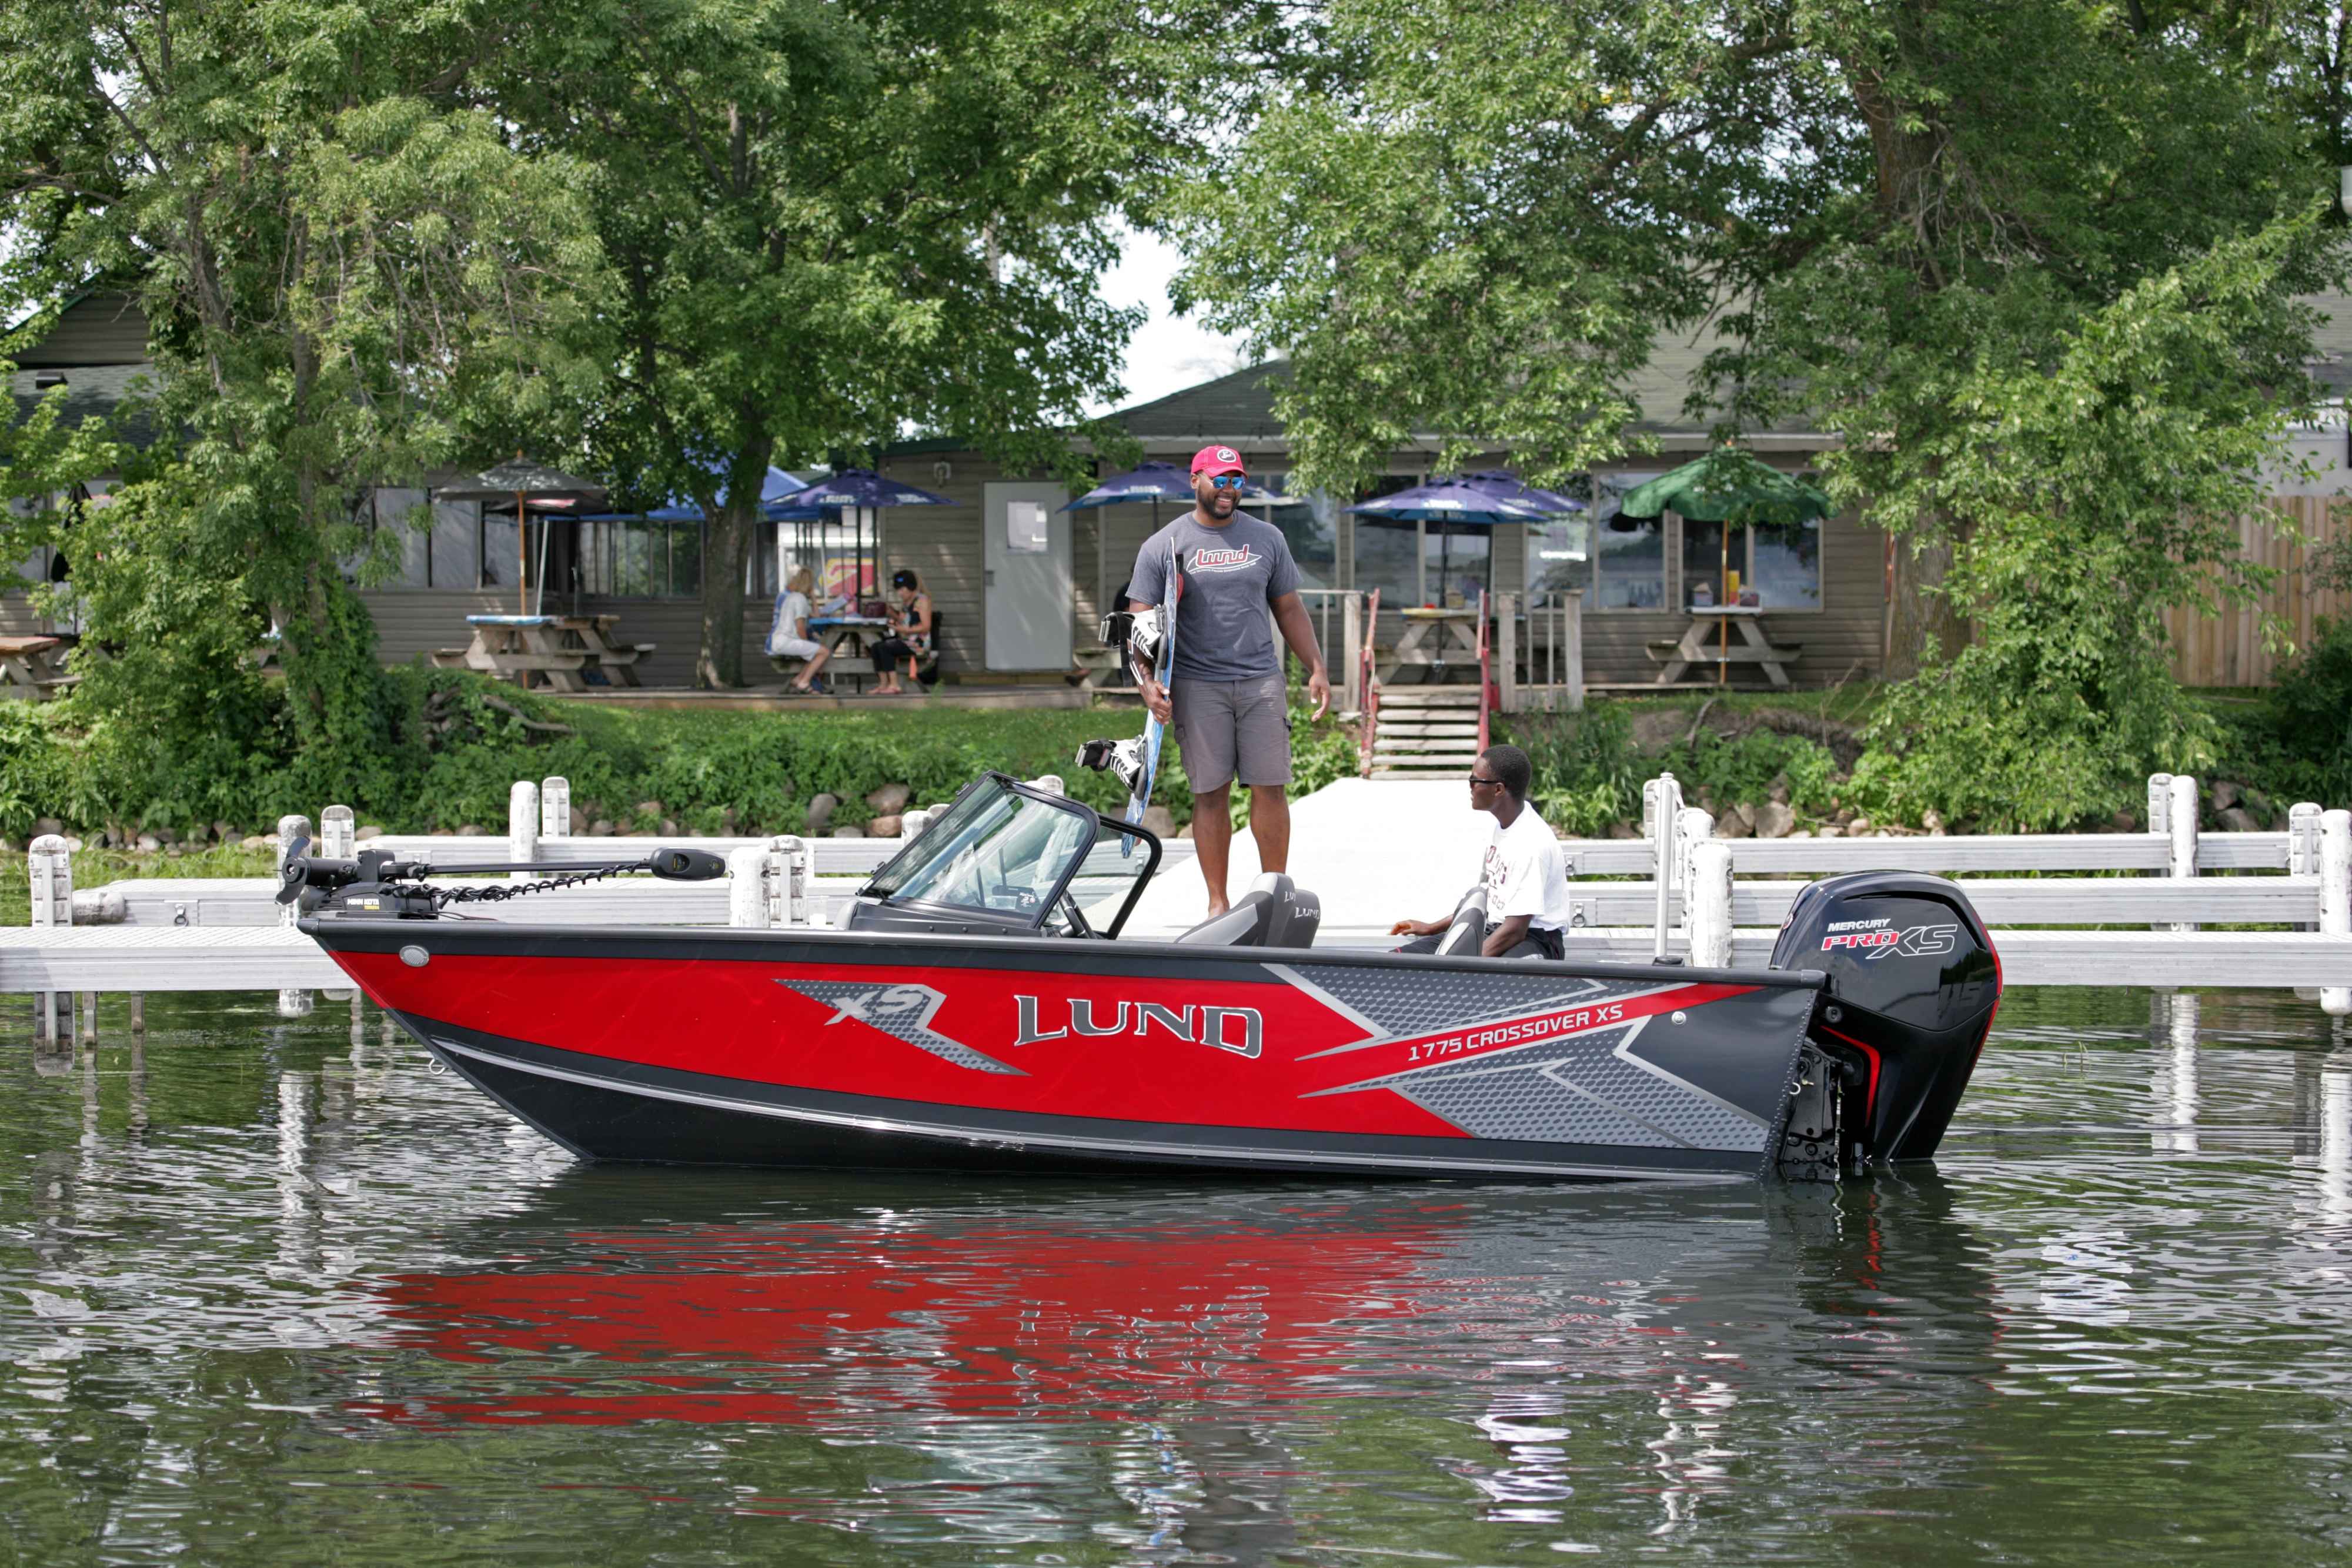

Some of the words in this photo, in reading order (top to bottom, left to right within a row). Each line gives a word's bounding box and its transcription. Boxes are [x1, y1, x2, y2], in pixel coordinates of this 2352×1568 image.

[1295, 907, 1320, 920] LUND
[1828, 918, 1890, 932] MERCURY
[1821, 931, 1900, 951] PRO
[1014, 995, 1262, 1059] LUND
[1408, 1037, 1462, 1061] 1775
[1466, 1011, 1590, 1049] CROSSOVER
[1596, 1004, 1623, 1023] XS
